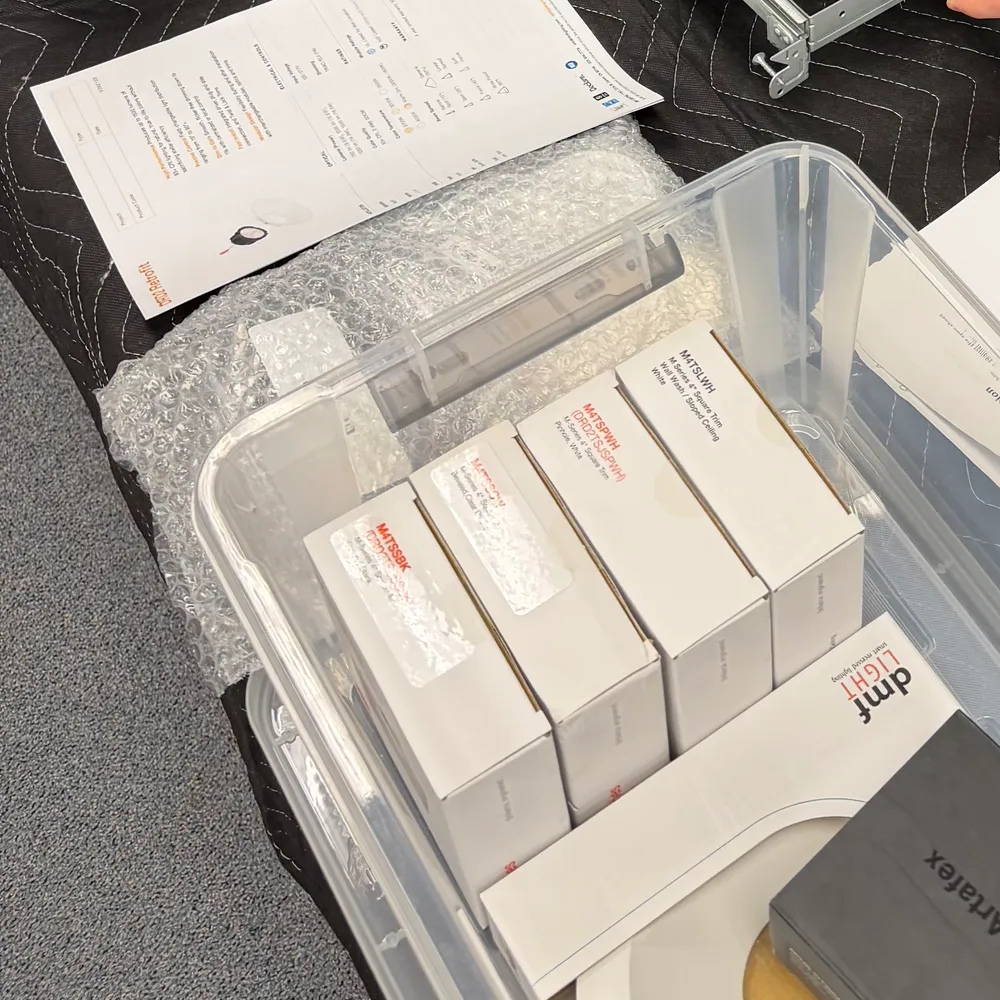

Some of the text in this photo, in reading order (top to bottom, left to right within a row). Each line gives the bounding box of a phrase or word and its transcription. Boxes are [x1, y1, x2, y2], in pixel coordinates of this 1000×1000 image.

[137, 261, 162, 291] Retrofit
[650, 366, 666, 385] White
[668, 355, 723, 428] M Series 4" Square Trim
[679, 348, 716, 394] M4TSLWH
[659, 360, 673, 376] Wall
[669, 374, 685, 394] Wash
[684, 396, 705, 420] Sloped
[700, 418, 720, 442] Ceiling
[562, 414, 582, 441] M-Series
[583, 446, 601, 468] Square
[598, 466, 609, 480] Trim
[569, 441, 583, 460] White
[582, 402, 620, 453] M4TSPWH
[375, 521, 411, 572] M4TSSBK
[830, 641, 887, 683] smart recessed lighting
[839, 648, 900, 700] LIGHT
[852, 666, 913, 724] dmf
